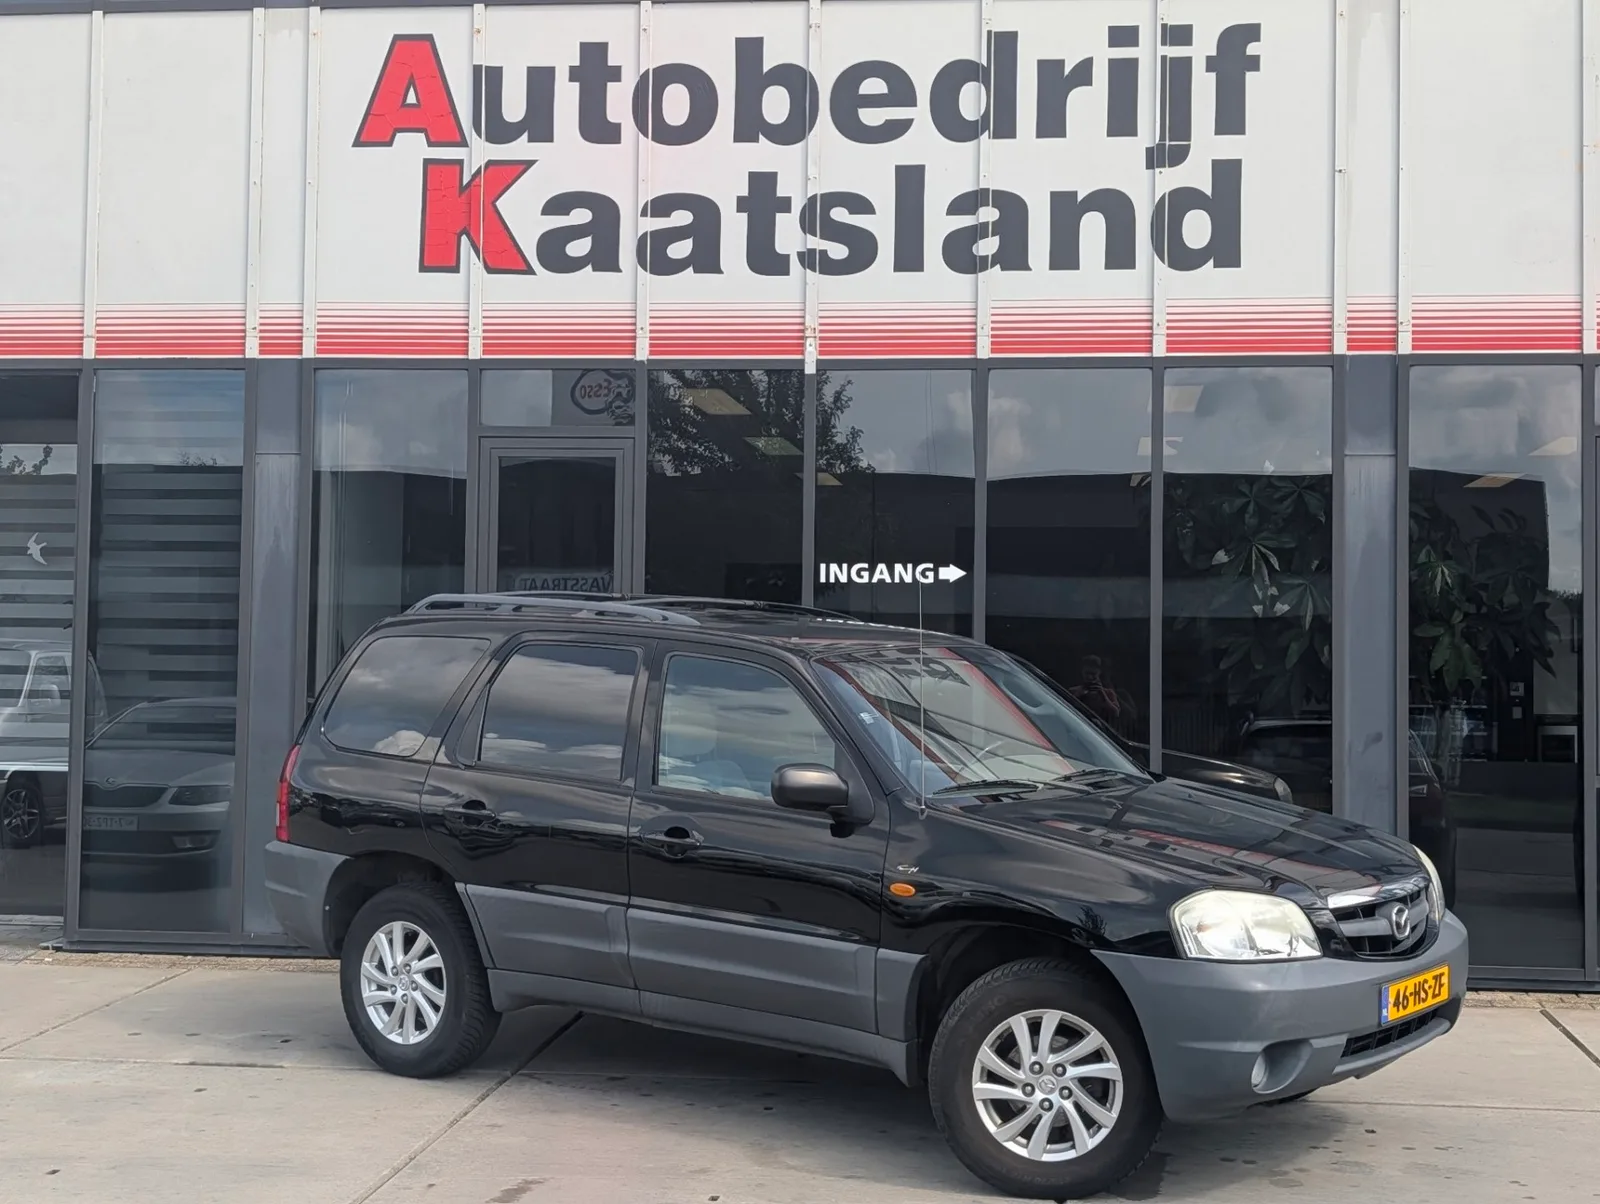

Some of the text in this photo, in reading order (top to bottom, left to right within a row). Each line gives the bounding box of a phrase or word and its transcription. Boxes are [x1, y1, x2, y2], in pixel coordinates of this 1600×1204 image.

[351, 22, 1262, 170] Autobedrijf
[418, 158, 1243, 277] Kaatsland
[819, 562, 935, 584] INGANG
[1392, 971, 1446, 1013] 46-HS-ZF
